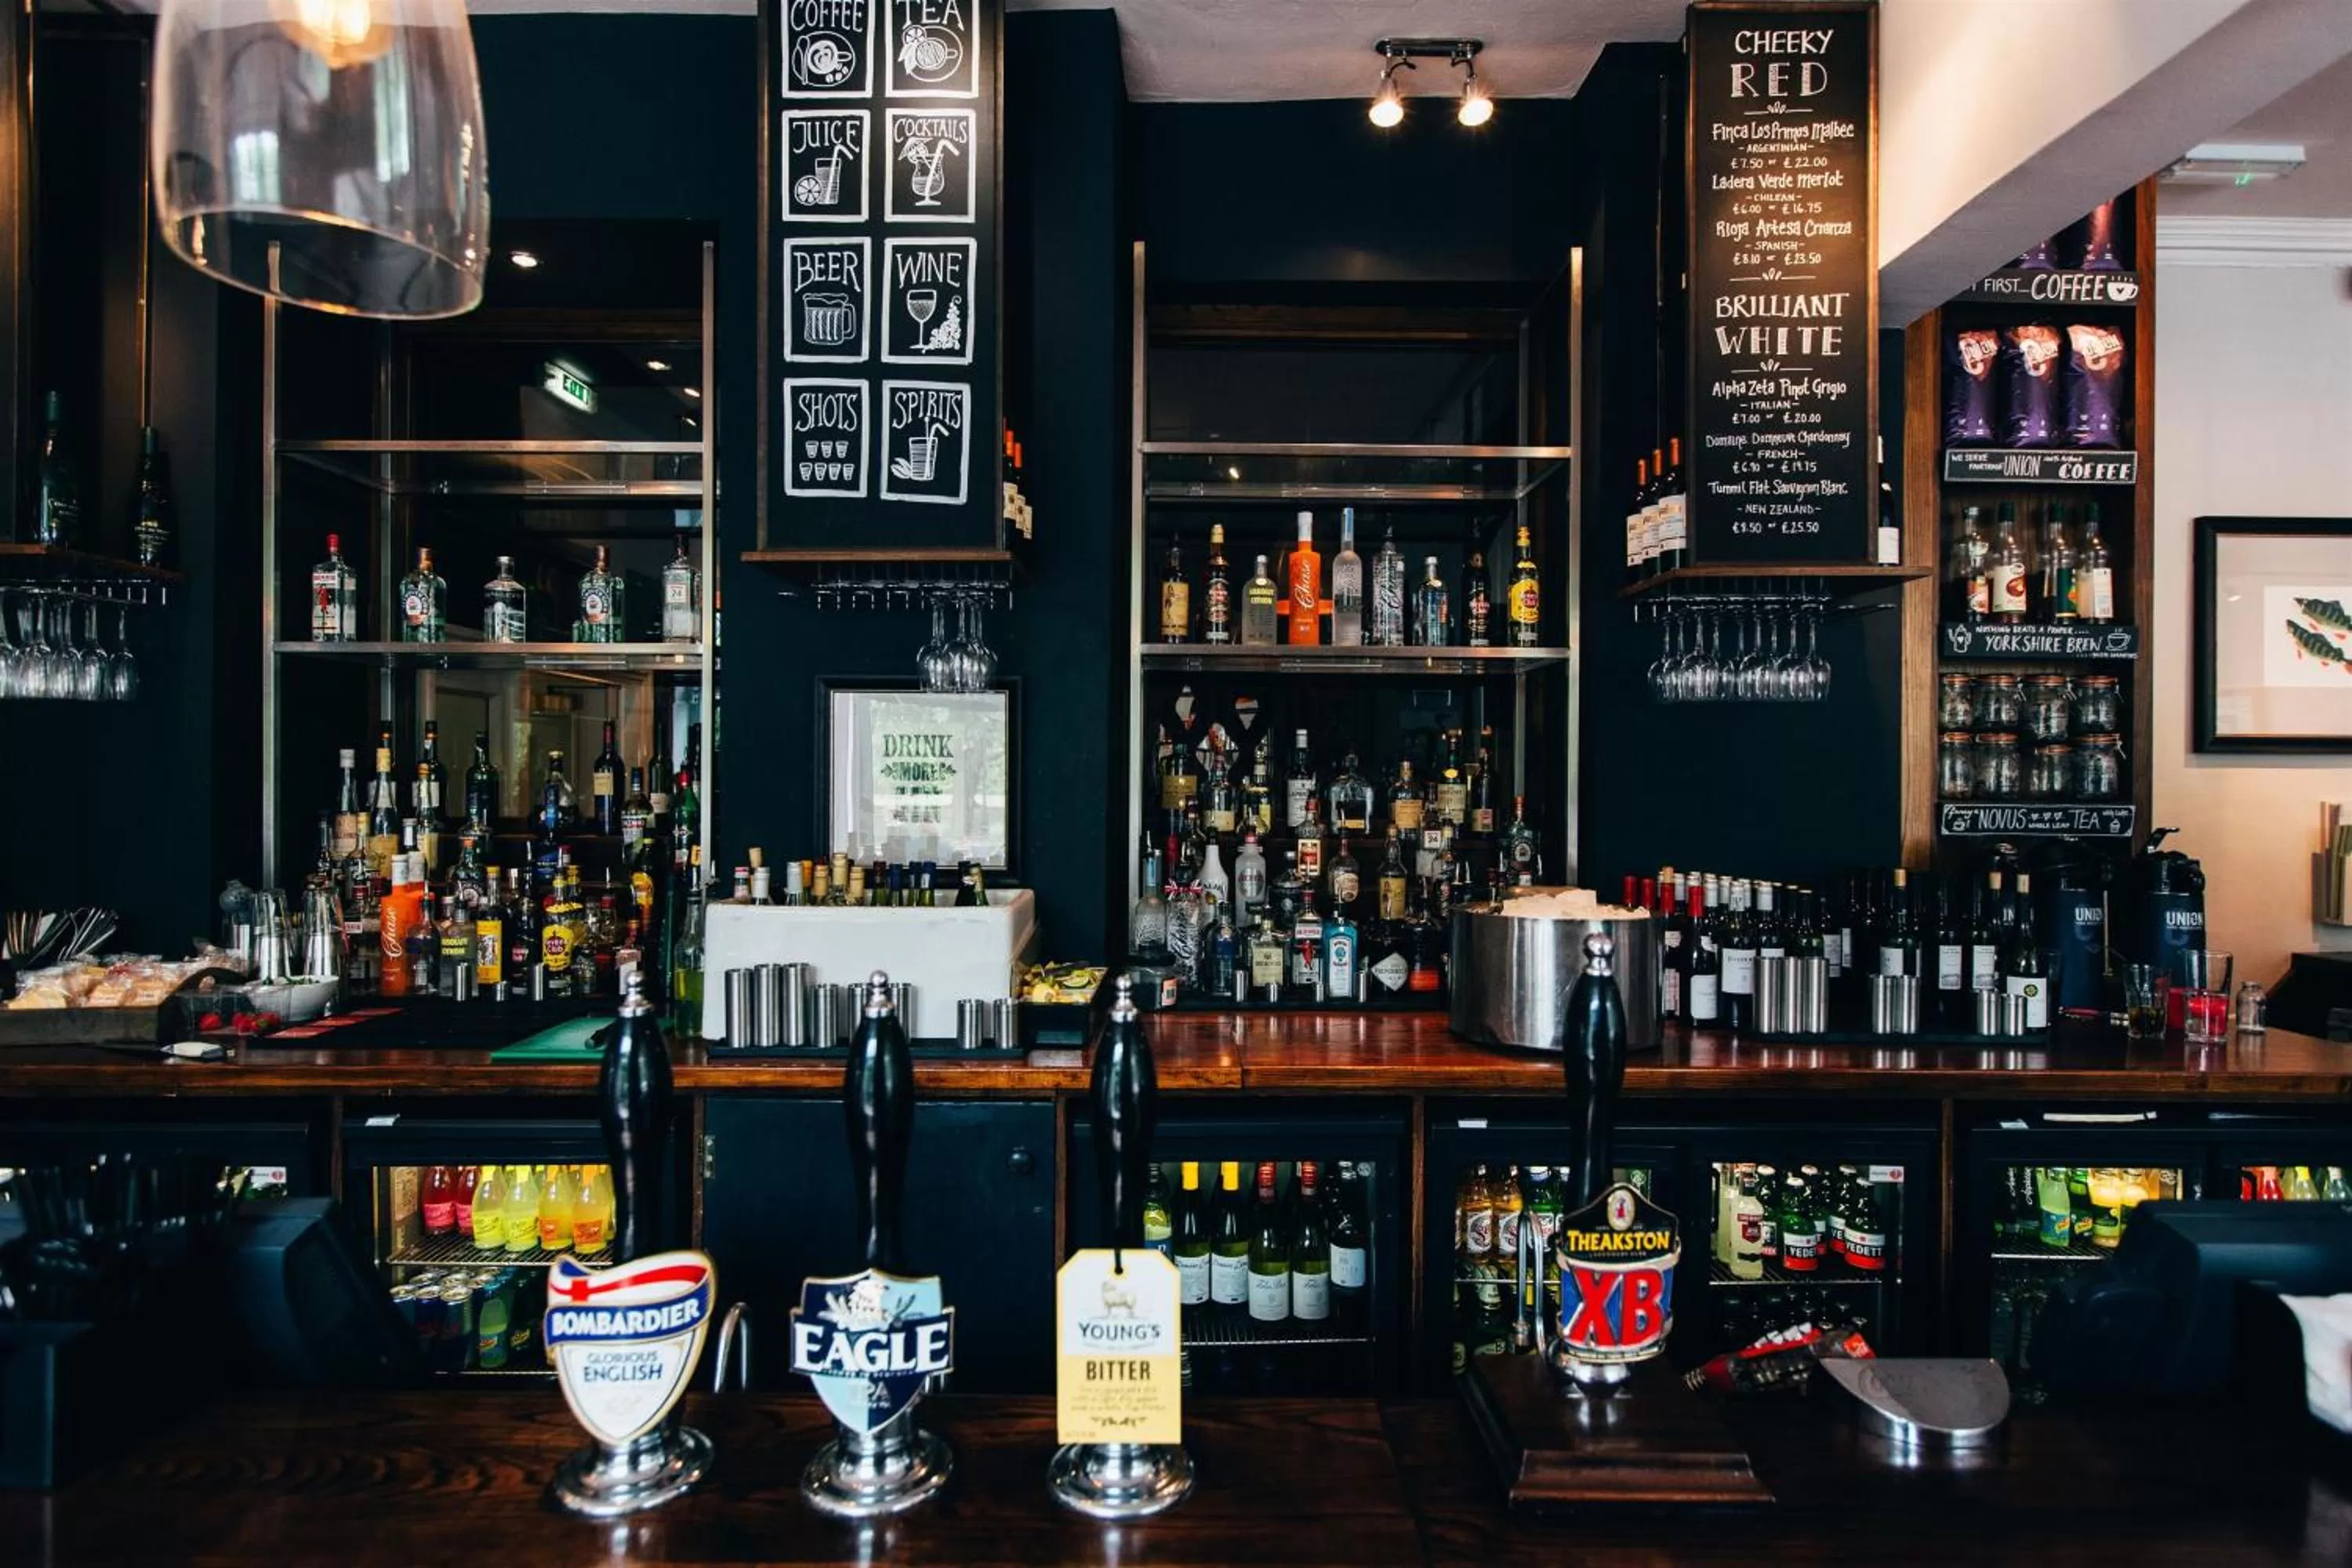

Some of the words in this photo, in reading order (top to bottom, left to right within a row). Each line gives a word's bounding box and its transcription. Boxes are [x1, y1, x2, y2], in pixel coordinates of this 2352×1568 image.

[789, 0, 863, 32] COFFEE
[902, 0, 964, 31] TEA
[1734, 29, 1835, 55] CHEEKY
[1730, 62, 1828, 97] RED
[793, 119, 861, 154] JUICE
[894, 118, 968, 144] COCKTAILS
[1711, 123, 1749, 143] Finca
[1711, 173, 1755, 190] Ladera
[1758, 172, 1794, 189] Verde
[1715, 220, 1750, 242] Rioja
[1755, 218, 1801, 238] Artesa
[793, 250, 862, 292] BEER
[895, 251, 963, 289] WINE
[2031, 273, 2107, 302] COFFEE
[1715, 292, 1849, 318] BRILLIANT
[1714, 325, 1843, 355] WHITE
[1712, 379, 1746, 401] Alpha
[1748, 378, 1776, 396] Zeta
[1812, 377, 1847, 401] Grigio
[794, 392, 858, 432] SHOTS
[891, 390, 962, 430] SPIRITS
[2003, 455, 2042, 477] UNION
[2058, 462, 2132, 480] COFFEE
[1985, 634, 2063, 653] YORKSHIRE
[2066, 635, 2103, 653] BREW
[883, 734, 954, 758] DRINK
[1978, 808, 2027, 829] NOVUS
[2068, 808, 2101, 829] TEA
[1567, 1229, 1671, 1252] THEAKSTON
[1789, 1245, 1816, 1258] VEDE
[1846, 1241, 1882, 1257] VEDETT
[550, 1298, 701, 1337] BOMBARDIER
[1566, 1267, 1664, 1348] XB
[1077, 1322, 1162, 1342] YOUNG'S
[588, 1349, 659, 1364] GLORIOUS
[793, 1320, 949, 1373] EAGLE
[583, 1364, 663, 1383] ENGLISH
[1086, 1359, 1151, 1381] BITTER
